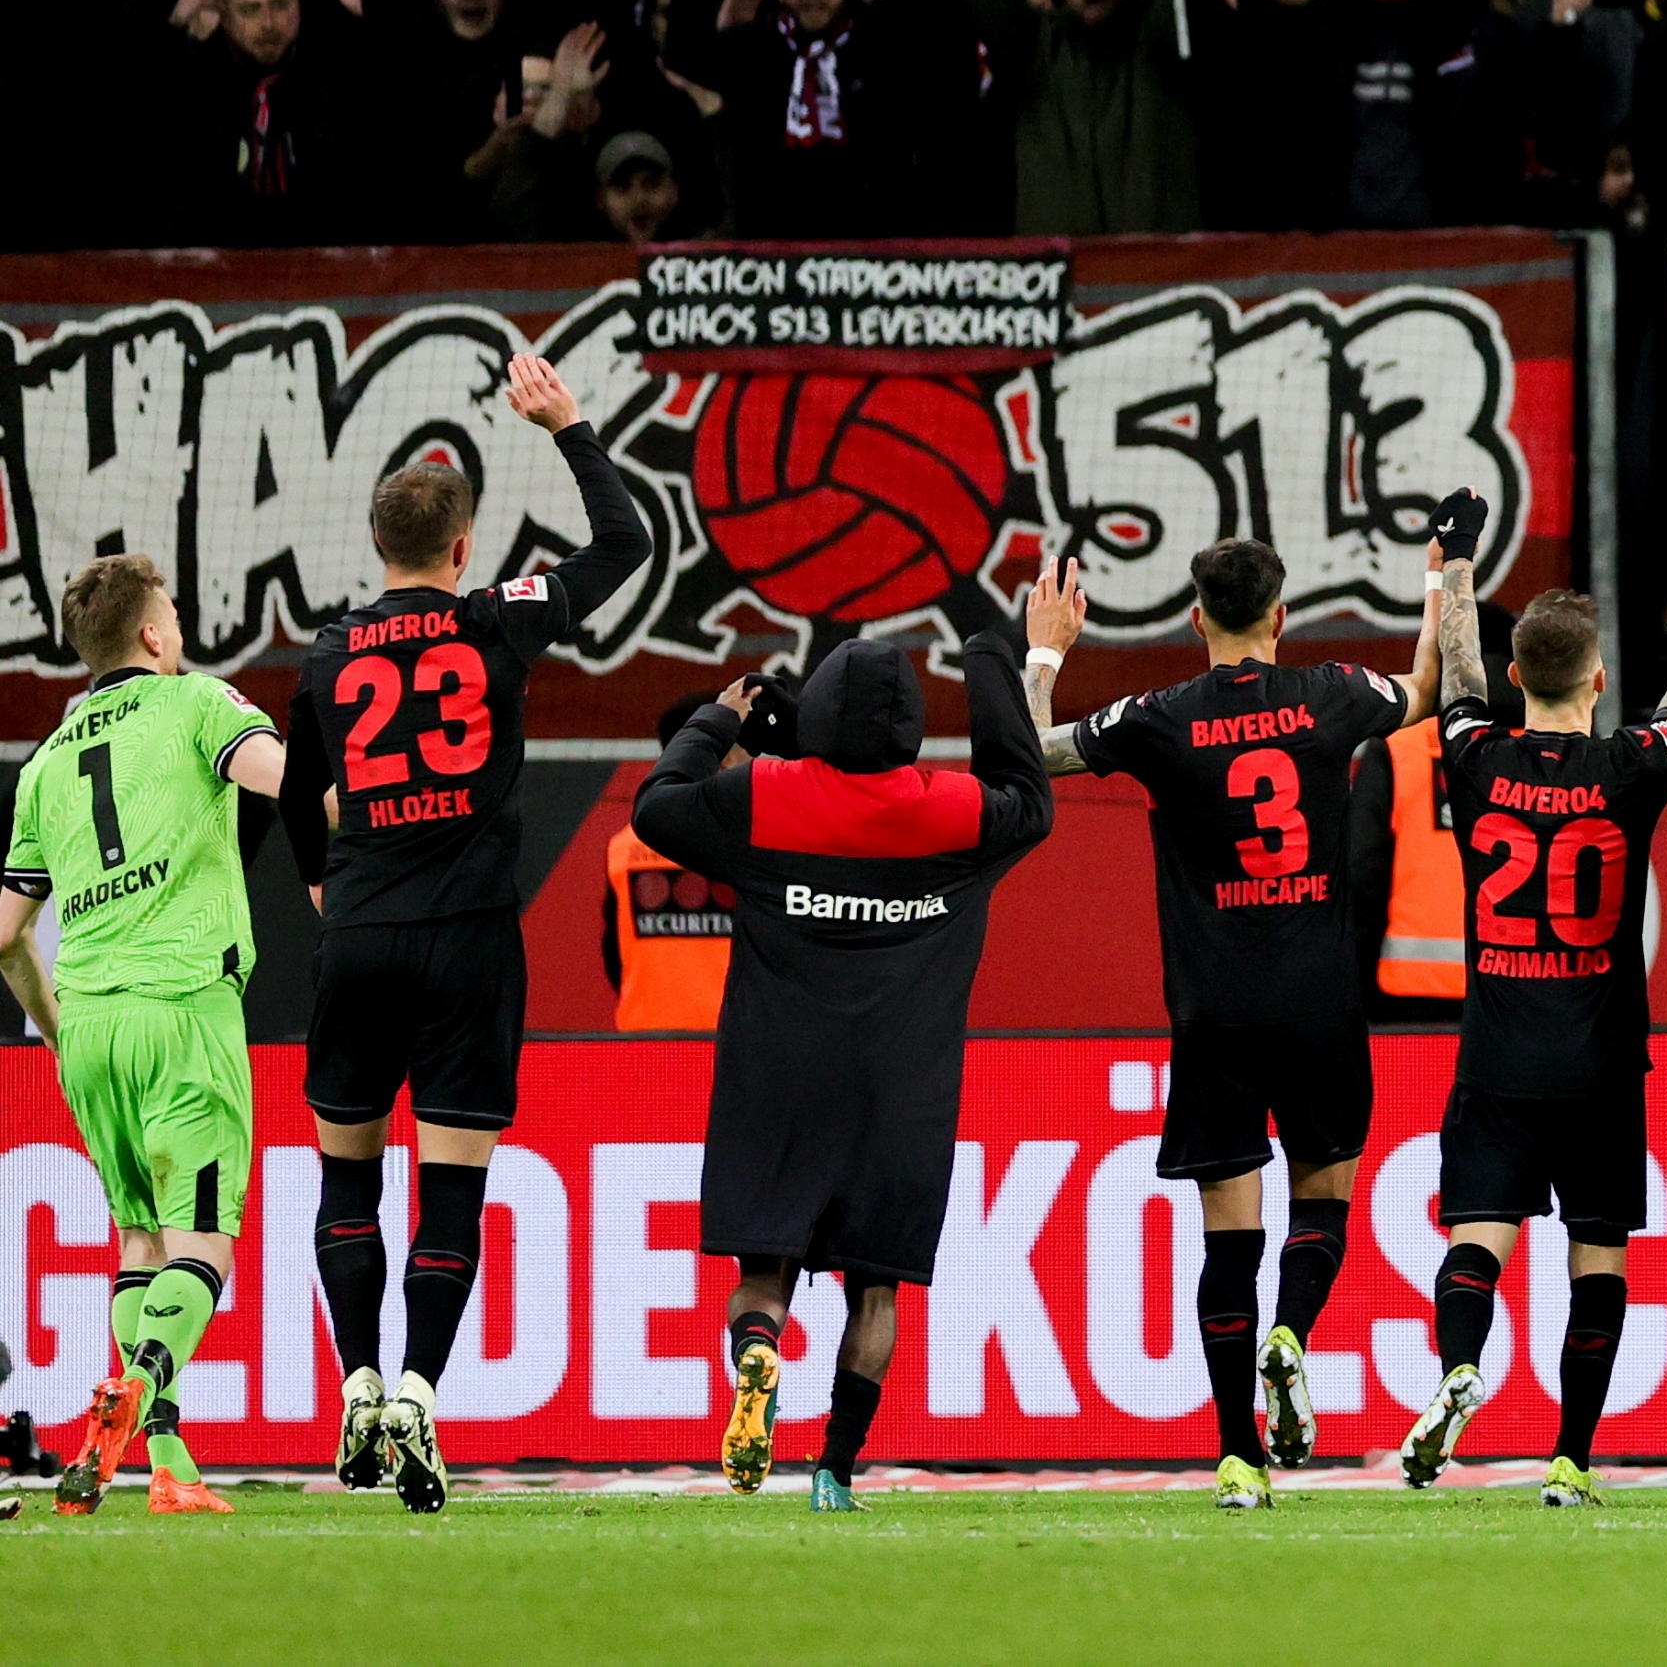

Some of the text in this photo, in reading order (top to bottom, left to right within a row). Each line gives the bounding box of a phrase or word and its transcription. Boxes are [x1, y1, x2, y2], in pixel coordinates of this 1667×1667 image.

[648, 255, 1066, 302] SEKTION STADIONVERBOT
[647, 301, 1060, 348] CHAOS 513 LEVERKUSEN
[1047, 294, 1512, 619] 513
[334, 643, 492, 792] 23
[79, 742, 126, 871] 1
[369, 788, 472, 828] HLOŽEK
[1227, 748, 1309, 878] 3
[62, 858, 169, 926] HRADECKY
[785, 885, 948, 923] Barmenia
[1216, 874, 1328, 909] HINCAPIE
[1470, 812, 1627, 948] 20
